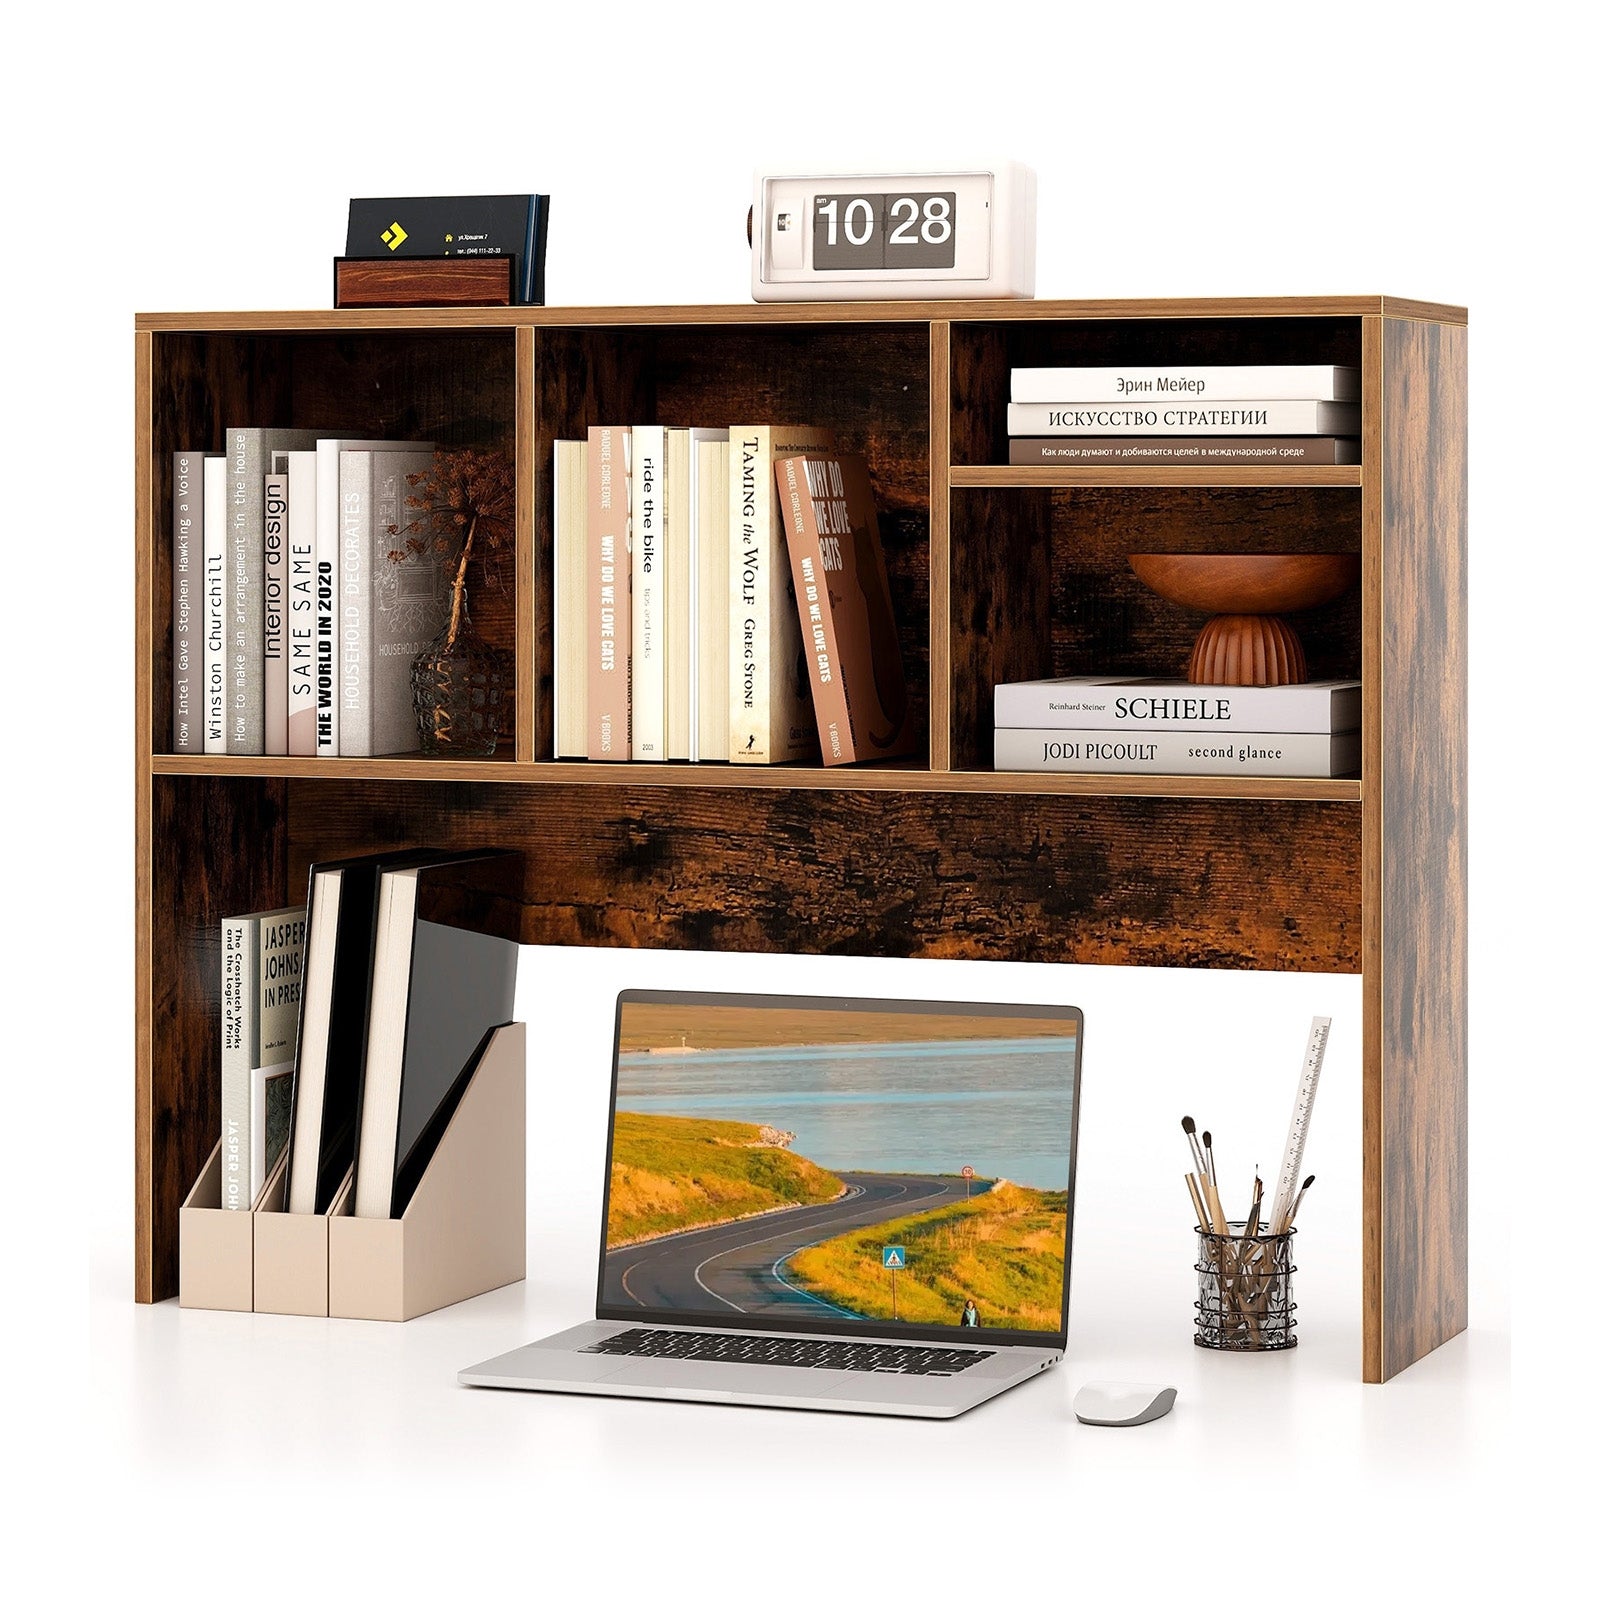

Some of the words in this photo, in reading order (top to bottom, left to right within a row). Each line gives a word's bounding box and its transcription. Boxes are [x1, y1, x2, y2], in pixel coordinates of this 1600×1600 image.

[818, 198, 874, 246] 10
[889, 197, 952, 244] 28
[1116, 378, 1152, 394] Эрин
[1156, 377, 1205, 395] Мейер
[1048, 411, 1157, 427] ИСКУССТВО
[1164, 410, 1268, 426] СТРАТЕГИИ
[234, 435, 246, 474] house
[1041, 447, 1057, 456] Как
[1058, 449, 1080, 458] люди
[1081, 449, 1113, 458] думают
[1122, 447, 1172, 457] добиваются
[1173, 447, 1199, 457] целей
[1208, 447, 1277, 458] международной
[1279, 449, 1305, 458] среде
[178, 458, 189, 497] Voice
[601, 464, 612, 510] CORLEONE
[643, 457, 654, 493] ride
[743, 436, 759, 517] TAMING
[802, 460, 829, 498] WHY
[828, 460, 844, 498] DO
[234, 482, 246, 505] the
[234, 513, 246, 529] in
[265, 483, 287, 565] design
[643, 500, 654, 529] the
[790, 493, 805, 534] CORLEONE
[811, 500, 830, 535] WE
[827, 500, 851, 534] LOVE
[178, 519, 191, 572] Hawking
[345, 492, 360, 594] DECORATES
[601, 535, 615, 563] WHY
[743, 523, 755, 545] the
[643, 535, 654, 573] bike
[819, 537, 843, 571] CATS
[234, 537, 249, 623] arrangement
[292, 544, 311, 611] SAME
[601, 566, 615, 583] DO
[743, 547, 759, 605] WOLF
[801, 556, 816, 584] WHY
[318, 561, 332, 612] 2020
[601, 586, 615, 605] WE
[643, 588, 652, 607] tips
[805, 585, 819, 602] DO
[178, 580, 191, 632] Stephen
[208, 554, 222, 651] Churchill
[265, 573, 281, 659] Interior
[809, 604, 821, 623] WE
[318, 616, 332, 636] IN
[601, 607, 615, 638] LOVE
[644, 609, 652, 630] and
[236, 631, 246, 647] an
[644, 632, 652, 659] tricks
[744, 618, 756, 659] GREG
[812, 623, 827, 653] LOVE
[178, 640, 189, 670] Gave
[292, 628, 311, 695] SAME
[345, 606, 360, 709] HOUSEHOLD
[601, 640, 615, 671] CATS
[817, 653, 832, 683] CATS
[234, 655, 246, 686] make
[318, 641, 332, 709] WORLD
[178, 678, 189, 715] Intel
[208, 663, 222, 739] Winston
[744, 663, 756, 709] STONE
[235, 694, 246, 709] to
[1049, 702, 1081, 711] Reinhard
[1082, 703, 1106, 711] Steiner
[1115, 697, 1232, 720] SCHIELE
[178, 722, 189, 745] How
[235, 717, 246, 741] How
[318, 713, 332, 747] THE
[1043, 742, 1080, 762] JODI
[1085, 743, 1158, 760] PICOULT
[1188, 745, 1233, 758] second
[1239, 746, 1283, 762] glance
[226, 929, 234, 950] and
[235, 927, 243, 949] The
[265, 921, 305, 950] JASPER
[226, 954, 234, 973] the
[265, 952, 299, 981] JOHNS
[224, 977, 234, 1006] Logic
[235, 953, 243, 1012] Crosshatch
[265, 987, 275, 1008] IN
[278, 983, 301, 1006] PRES
[226, 1009, 234, 1022] of
[226, 1024, 234, 1049] Print
[235, 1016, 243, 1049] Works
[228, 1118, 239, 1172] JASPER
